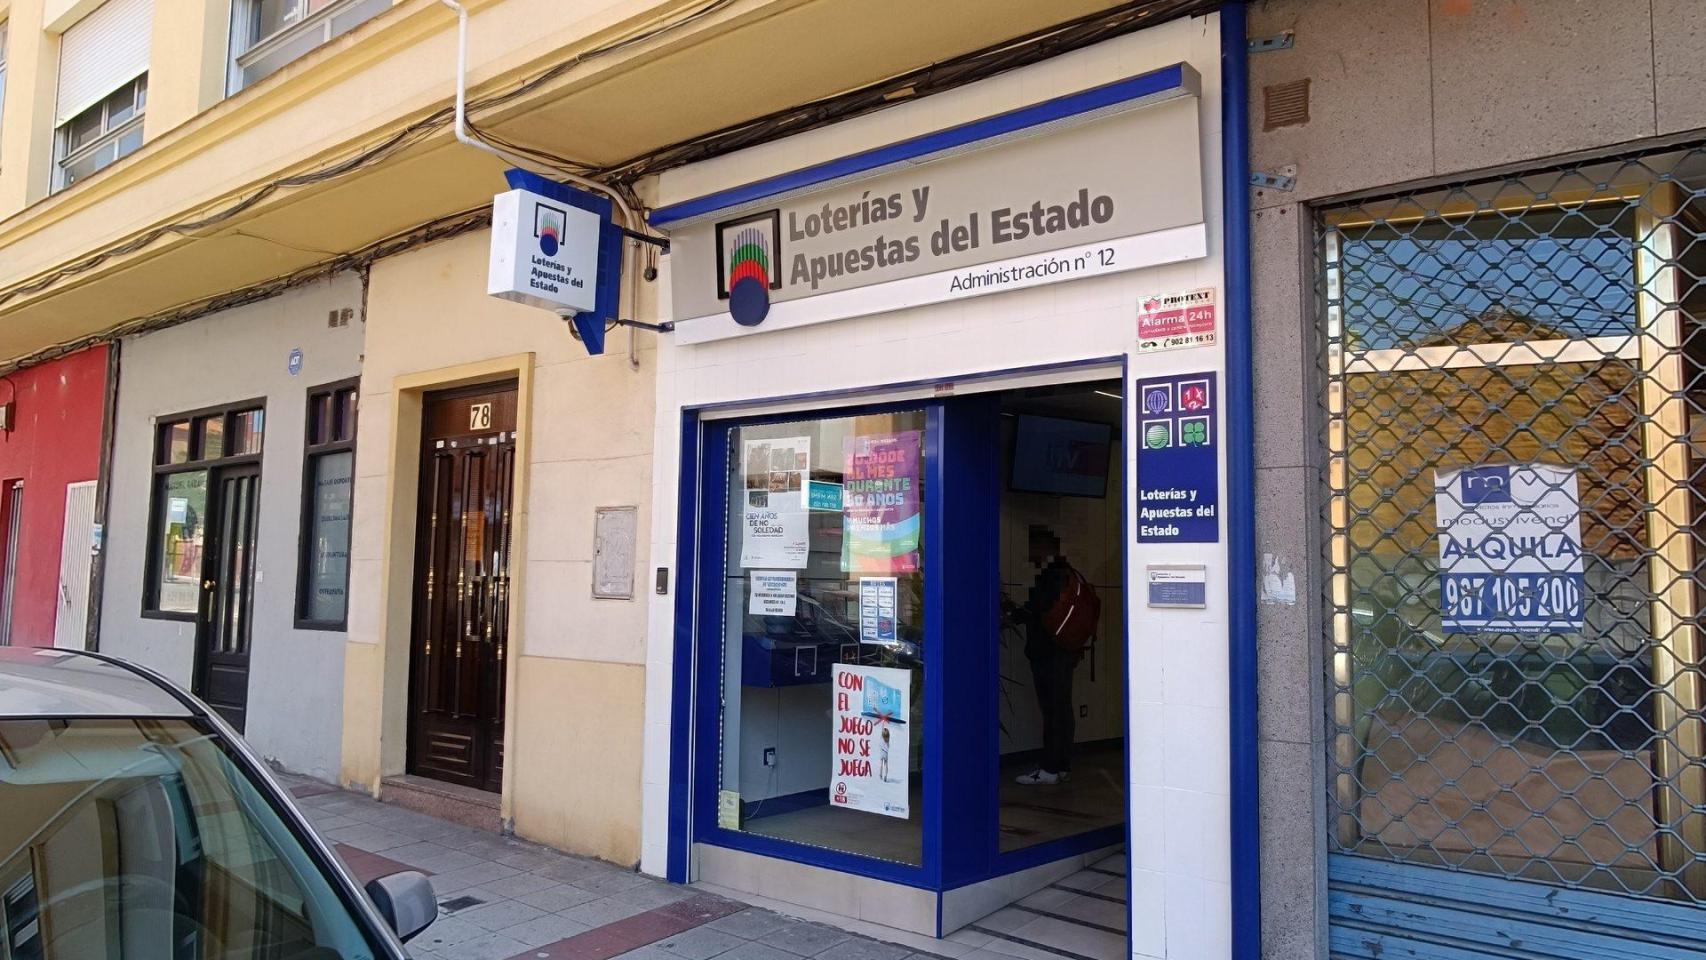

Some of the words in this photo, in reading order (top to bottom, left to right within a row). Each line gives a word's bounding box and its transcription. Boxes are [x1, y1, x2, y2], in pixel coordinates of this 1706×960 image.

[788, 191, 903, 242] Loterías
[911, 186, 930, 222] y
[790, 237, 921, 289] Apuestas
[931, 212, 979, 257] del
[992, 188, 1115, 245] Estado
[532, 255, 565, 272] Loterías
[567, 267, 572, 275] y
[949, 259, 1071, 293] Administración
[1097, 247, 1116, 268] 12
[530, 278, 559, 294] Estado
[531, 267, 569, 285] Apuestas
[571, 278, 583, 289] del
[1163, 292, 1210, 304] PROTEXT
[1142, 314, 1185, 328] Alarma
[1189, 310, 1212, 322] 24h
[1205, 333, 1214, 342] 13
[471, 404, 490, 429] 78
[867, 464, 895, 479] MES
[847, 477, 911, 493] DURANTE
[1140, 487, 1187, 501] Loterías
[1189, 489, 1198, 502] y
[1140, 508, 1193, 521] Apuestas
[1196, 504, 1215, 517] del
[1140, 523, 1180, 537] Estado
[1441, 536, 1578, 561] ALQUILA
[1446, 577, 1485, 616] 987
[1492, 577, 1531, 617] 105
[1537, 577, 1579, 617] 200
[838, 671, 863, 692] CON
[838, 692, 850, 712] EL
[838, 715, 873, 736] JUEGO
[837, 738, 855, 755] NO
[859, 738, 871, 757] SE
[838, 758, 873, 778] JUEGA
